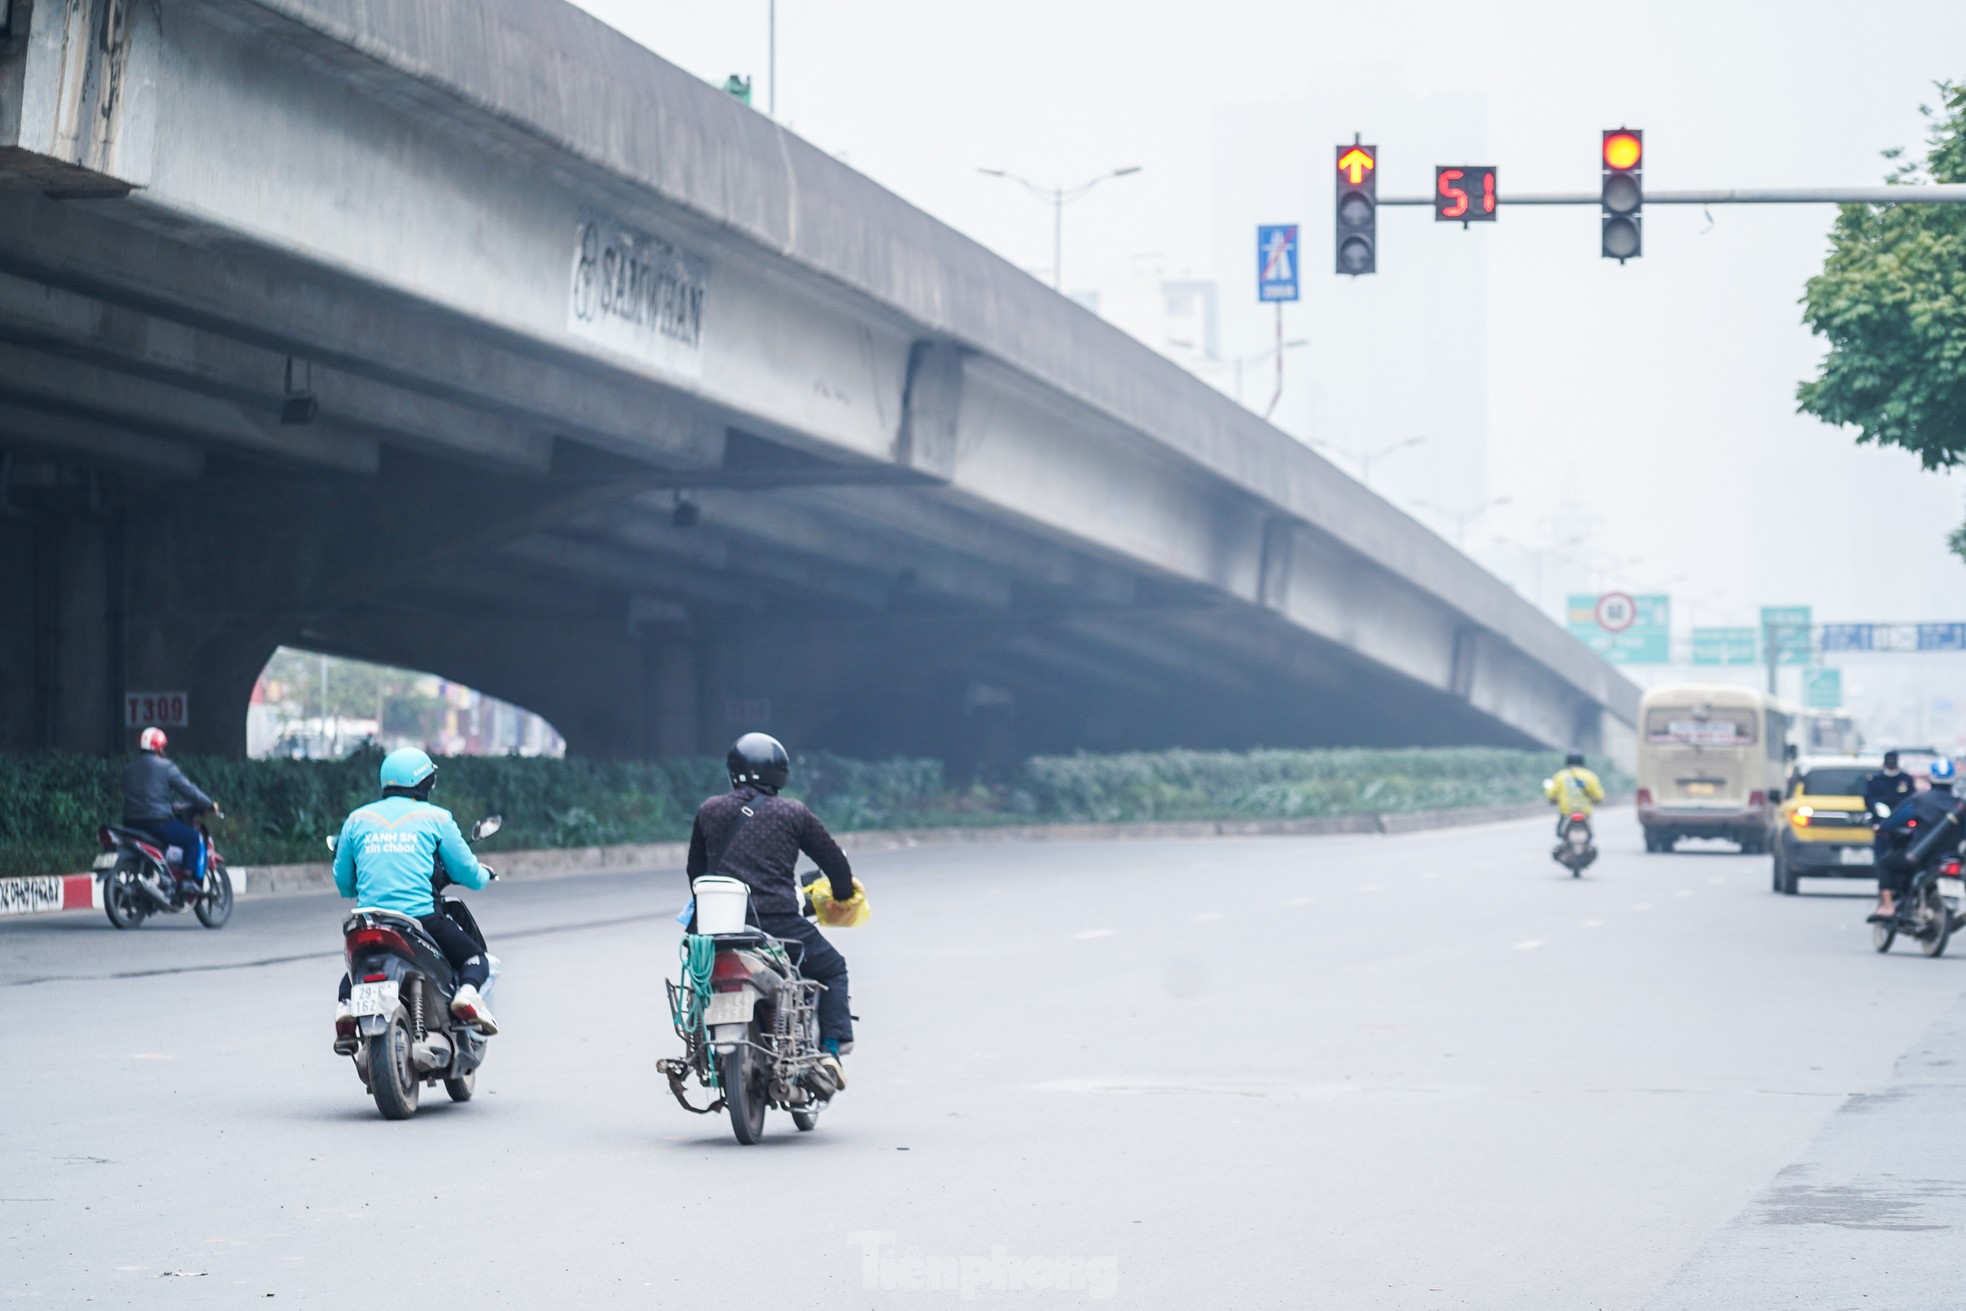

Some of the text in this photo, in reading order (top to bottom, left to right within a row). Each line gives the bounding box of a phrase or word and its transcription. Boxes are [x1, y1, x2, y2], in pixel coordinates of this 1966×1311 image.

[1438, 170, 1495, 217] 51
[364, 831, 418, 844] XANH SM
[364, 844, 381, 855] xin
